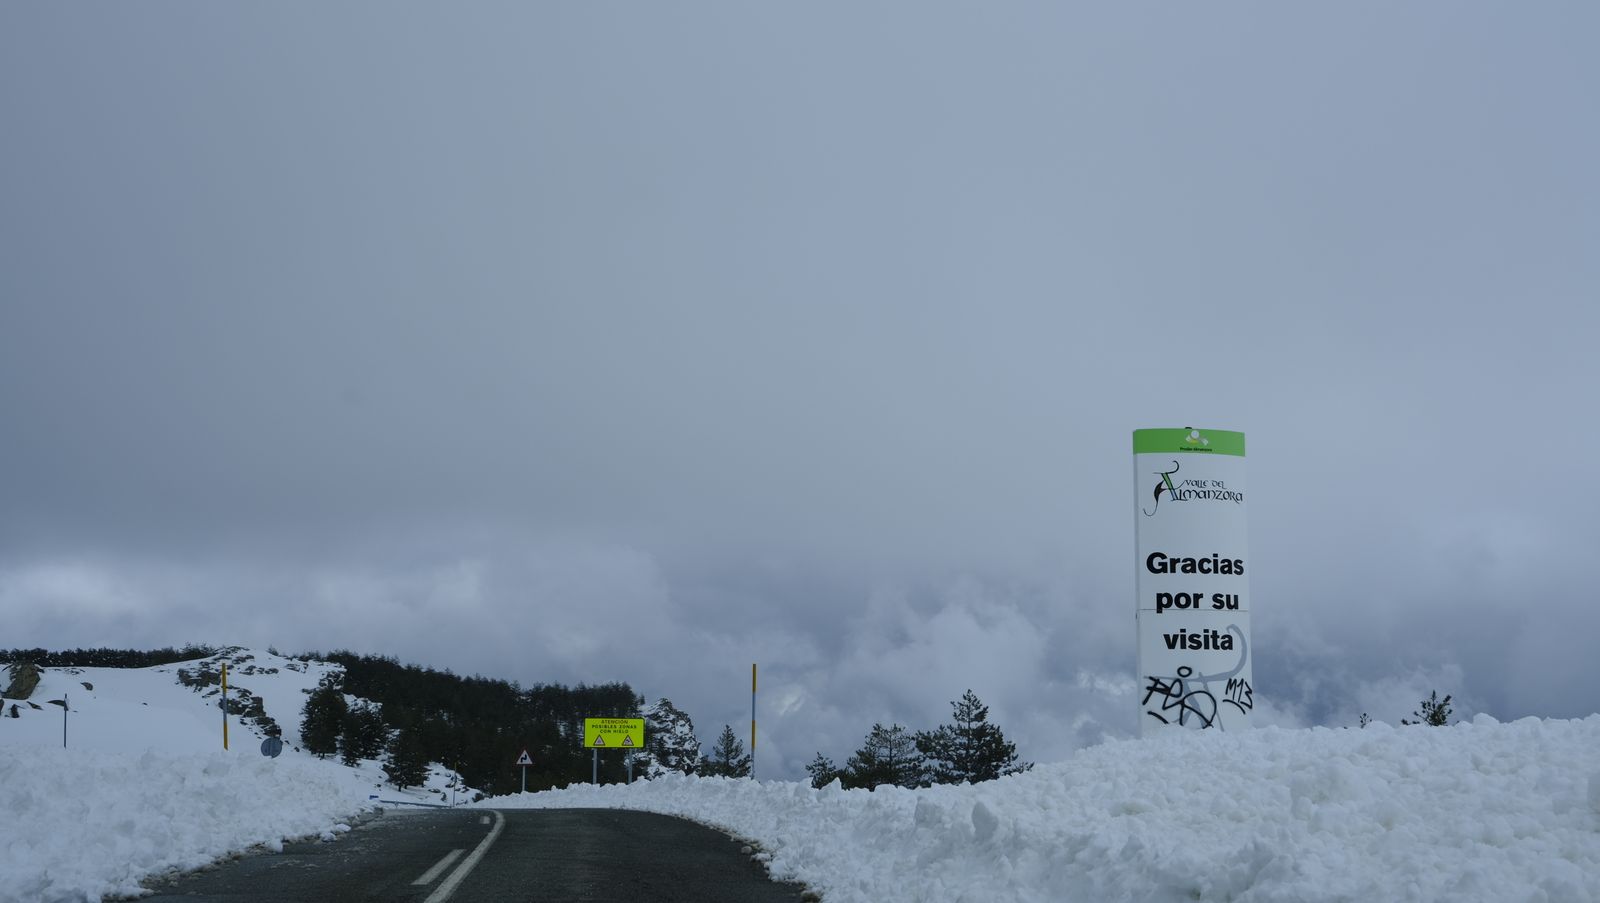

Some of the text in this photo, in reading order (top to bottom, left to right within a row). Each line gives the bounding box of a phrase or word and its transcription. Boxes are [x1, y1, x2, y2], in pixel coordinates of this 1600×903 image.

[1146, 551, 1244, 575] Gracias
[1156, 591, 1239, 614] por su
[1163, 629, 1233, 651] visita
